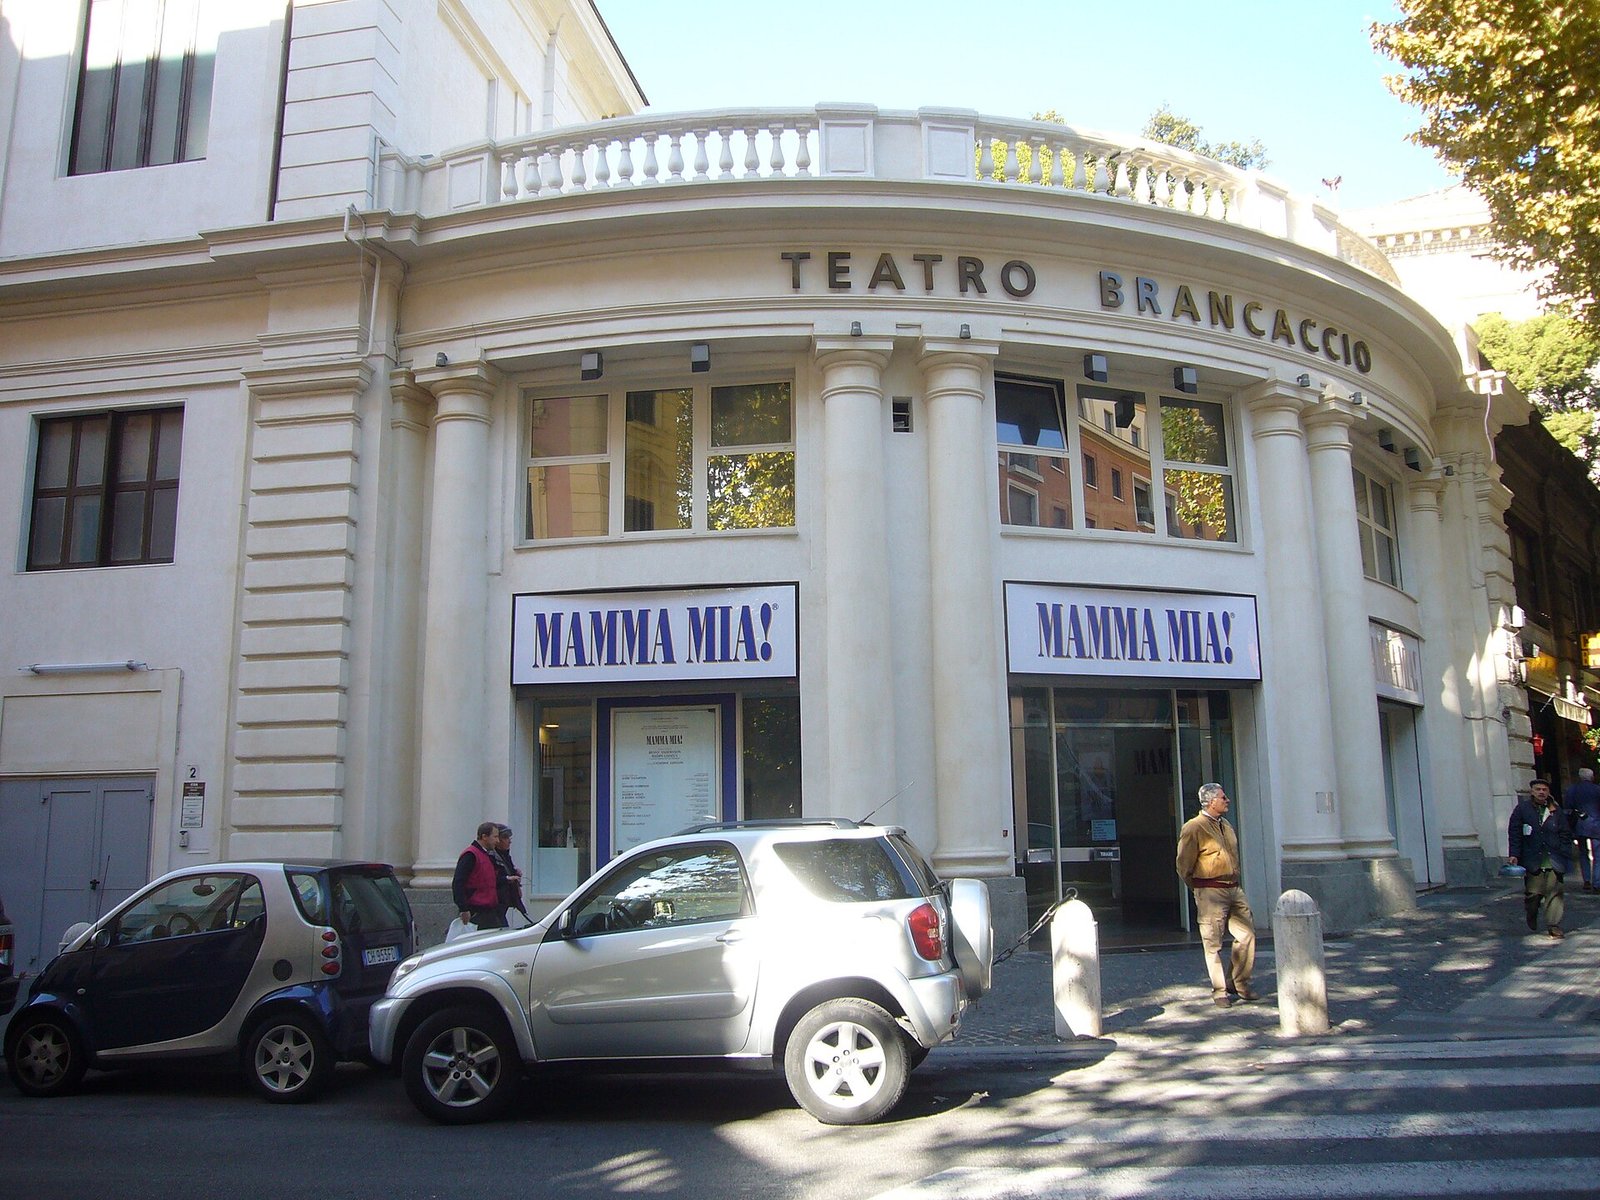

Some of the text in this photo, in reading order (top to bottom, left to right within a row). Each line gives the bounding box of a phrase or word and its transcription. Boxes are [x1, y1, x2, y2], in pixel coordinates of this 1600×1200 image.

[781, 251, 1372, 373] TEATRO BRANCACCIO
[532, 608, 677, 668] MAMMA
[1036, 602, 1161, 662] MAMMA
[646, 735, 669, 746] MAMMA
[190, 767, 197, 779] 2
